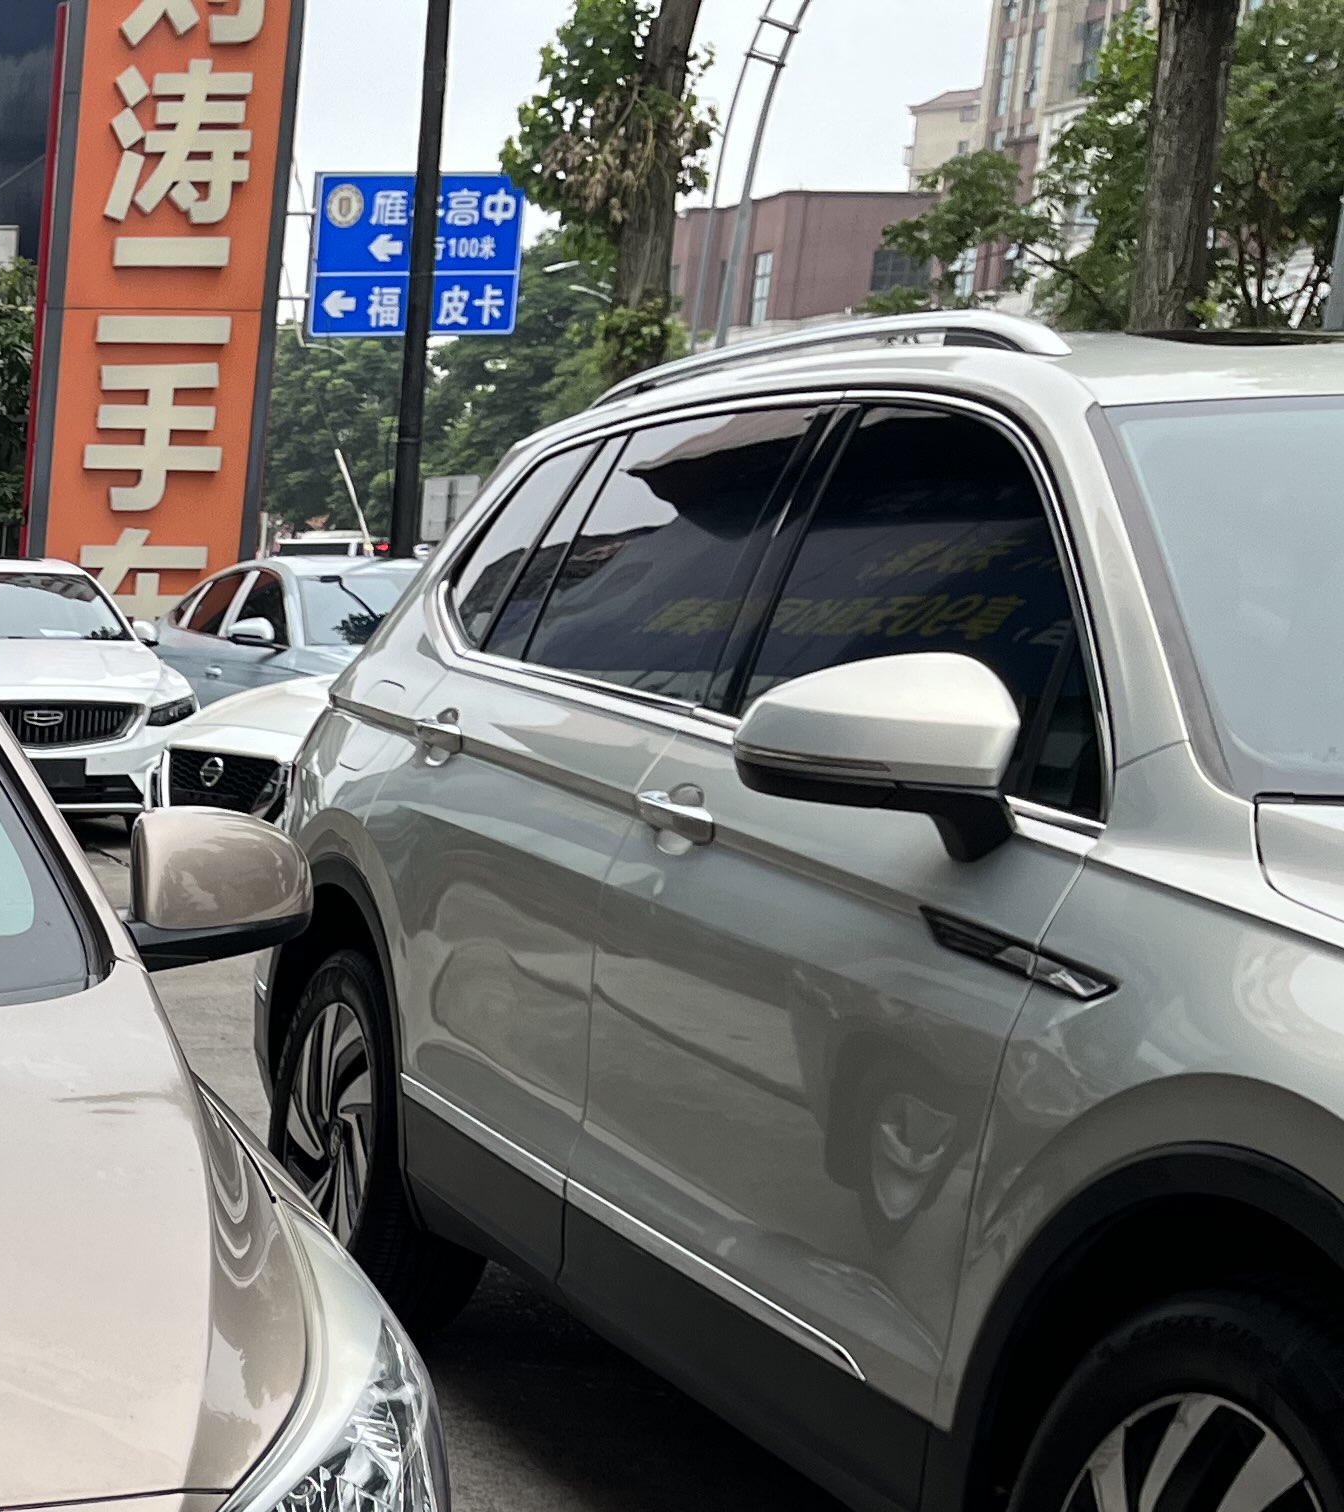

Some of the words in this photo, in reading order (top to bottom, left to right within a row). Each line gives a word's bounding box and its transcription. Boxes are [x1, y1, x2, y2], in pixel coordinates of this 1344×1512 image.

[369, 187, 516, 226] 雁高中
[367, 283, 505, 328] 福皮卡
